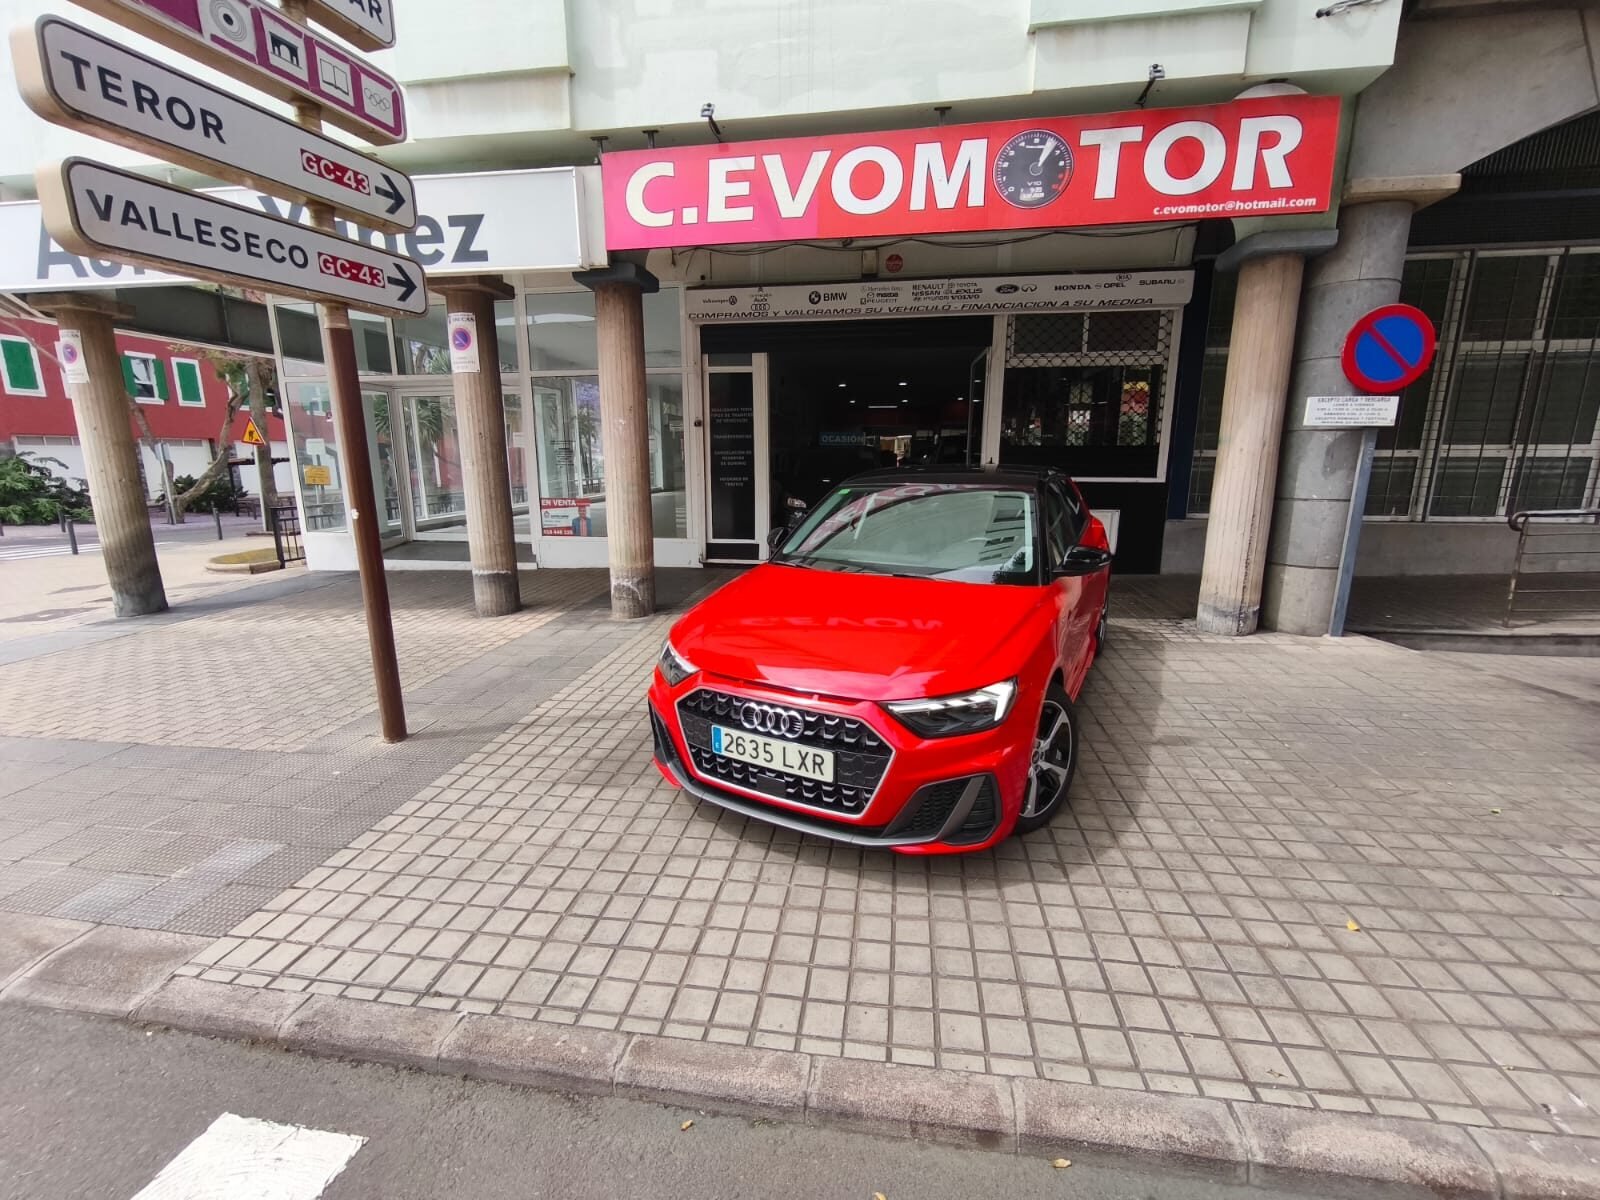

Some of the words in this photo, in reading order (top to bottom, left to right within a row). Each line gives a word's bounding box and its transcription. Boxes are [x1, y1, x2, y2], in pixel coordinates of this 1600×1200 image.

[60, 50, 226, 144] TEROR
[301, 152, 370, 194] GC-43
[1153, 197, 1317, 216] c.evomotor@hotmail.com
[86, 188, 308, 270] VALLESECO
[318, 253, 384, 288] GC-43
[689, 311, 768, 319] COMPRAMOS
[785, 307, 861, 316] VALORAMOS
[865, 306, 883, 314] SU
[1097, 297, 1153, 306] MEDIDA
[823, 291, 847, 301] BMW
[724, 733, 774, 763] 2635
[782, 746, 825, 776] LXR
